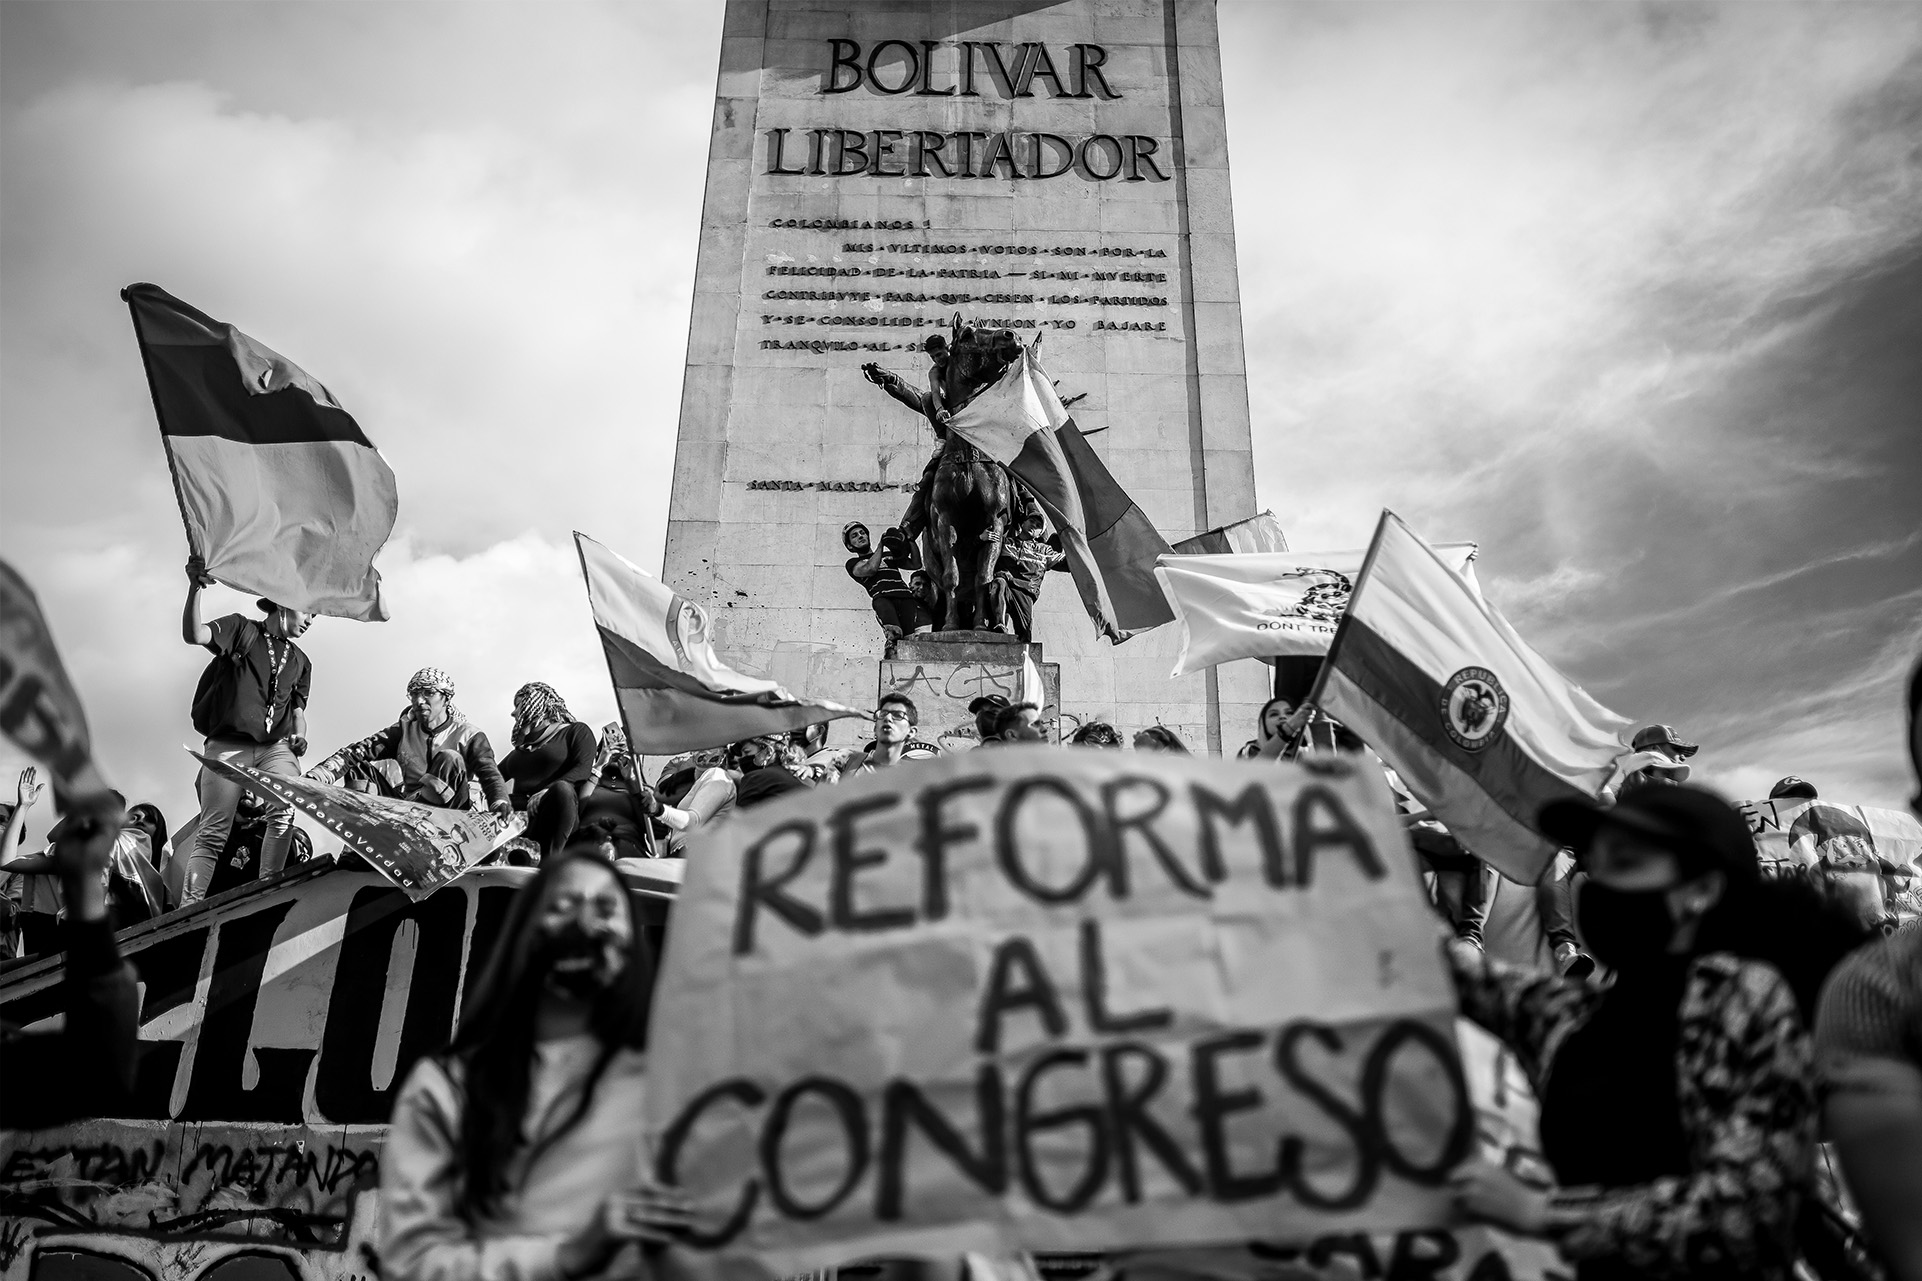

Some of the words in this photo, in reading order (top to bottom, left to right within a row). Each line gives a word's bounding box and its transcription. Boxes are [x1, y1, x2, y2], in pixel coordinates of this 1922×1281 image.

[820, 38, 1122, 99] BOLIVAR
[766, 128, 1171, 182] LIBERTADOR
[843, 243, 873, 253] MIS
[980, 245, 1038, 255] VOTOS
[1053, 247, 1086, 257] SON
[1102, 247, 1136, 257] POR
[1146, 249, 1168, 258] LA
[767, 266, 862, 276] FELICIDAD
[874, 268, 900, 277] DE
[907, 268, 929, 278] LA
[937, 269, 1002, 279] PATRIA
[1031, 270, 1048, 280] SI
[1057, 271, 1080, 281] MI
[884, 292, 928, 302] PARA
[983, 294, 1035, 303] CESEN
[1050, 295, 1080, 304] LOS
[761, 314, 774, 325] Y
[784, 315, 806, 326] SE
[817, 316, 924, 327] CONSOLIDE
[1051, 320, 1076, 330] YO
[1093, 320, 1167, 331] BAJARE
[867, 342, 891, 352] AL
[747, 480, 804, 492] SANTA
[816, 481, 883, 492] MARTA
[1309, 624, 1338, 635] TRE
[733, 774, 1390, 957] REFORMA
[976, 920, 1174, 1054] AL
[655, 1020, 1477, 1252] CONGRESO
